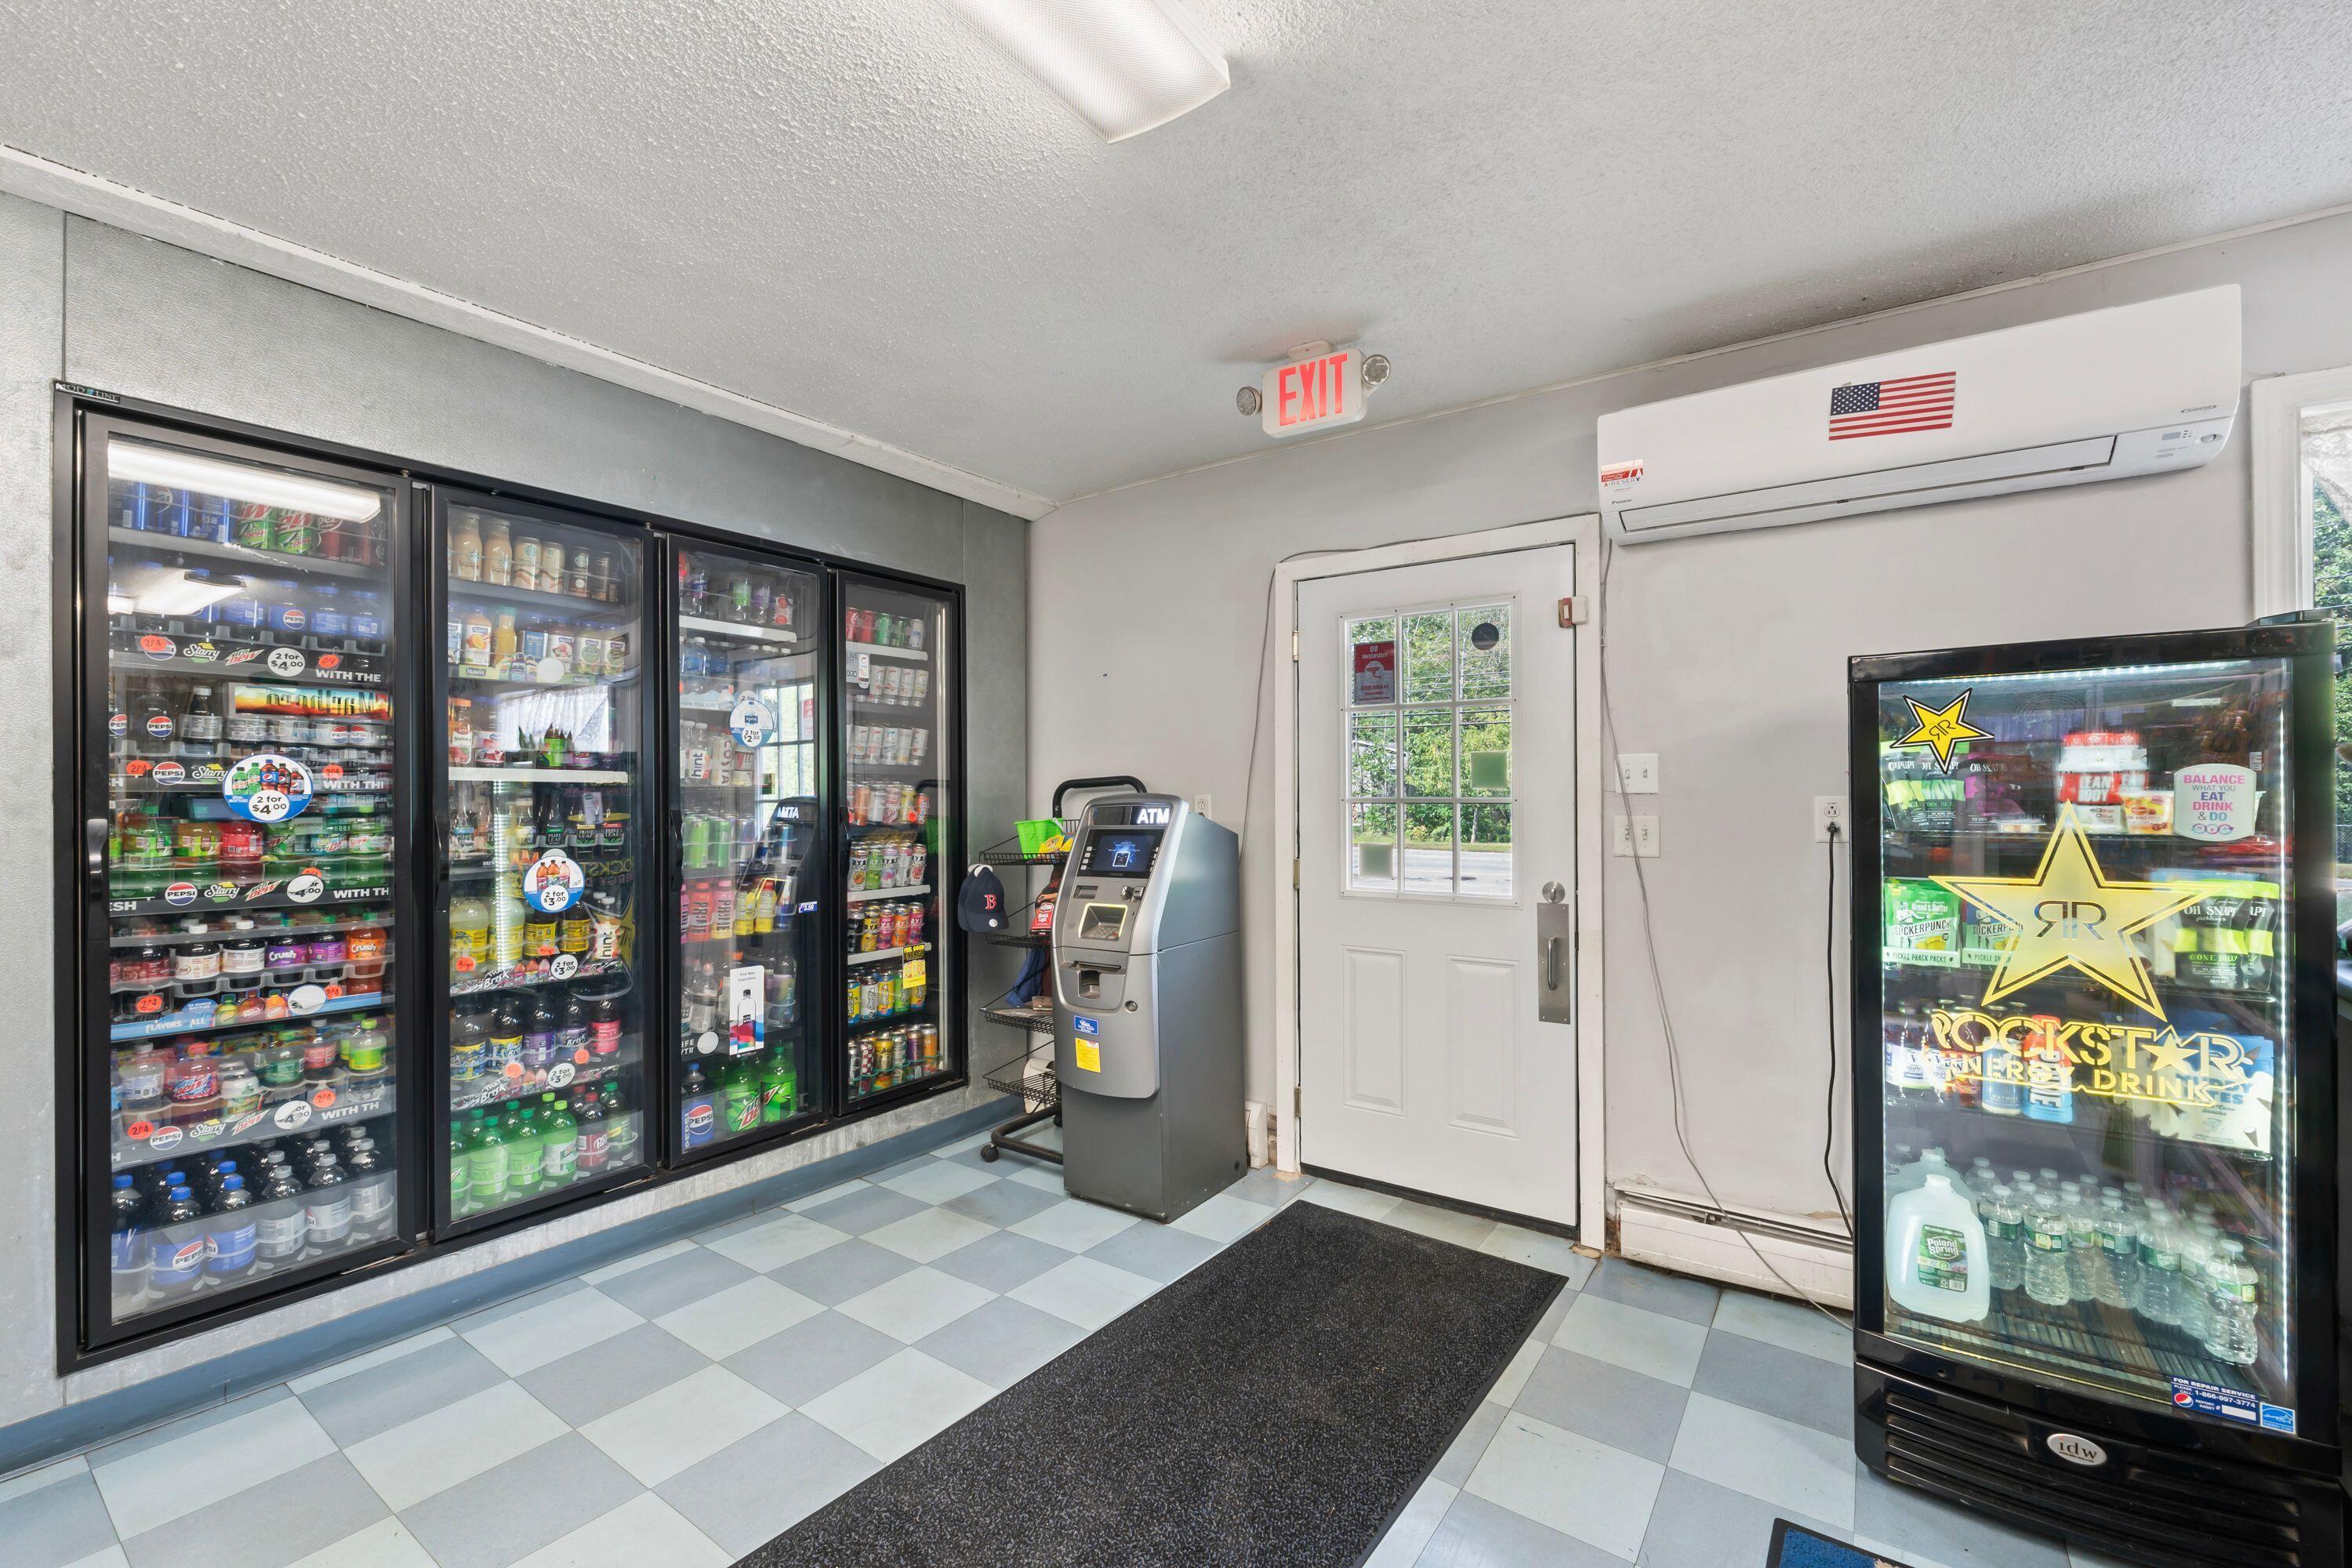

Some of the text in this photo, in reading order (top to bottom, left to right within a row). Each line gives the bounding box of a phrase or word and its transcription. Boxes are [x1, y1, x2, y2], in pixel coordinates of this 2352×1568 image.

[1279, 354, 1348, 426] EXIT
[183, 644, 220, 661] Starry
[270, 660, 303, 671] $4.00
[315, 669, 382, 683] WITH THE
[691, 753, 703, 777] hint
[192, 766, 228, 782] Starry
[2184, 775, 2245, 784] BALANCE
[323, 780, 360, 789] WITH
[2201, 792, 2224, 800] EAT
[252, 804, 287, 815] $4.00
[2193, 801, 2233, 811] DRINK
[1137, 808, 1170, 824] ATM
[2198, 811, 2227, 821] & DO
[204, 884, 240, 898] Starry
[333, 889, 370, 899] WITH
[543, 896, 567, 906] $3.00
[985, 895, 997, 909] B
[2183, 906, 2201, 915] OH
[1894, 920, 1950, 936] SUCKERPUNCH
[351, 942, 376, 953] Crush
[601, 931, 612, 958] hint
[269, 951, 296, 961] Crush
[1974, 953, 1992, 962] PICKLE
[554, 966, 575, 975] $3.00
[550, 1073, 572, 1083] $3.00
[2094, 1069, 2213, 1105] DRINK
[321, 1106, 359, 1120] WITH
[689, 1114, 713, 1126] PEPSI
[190, 1123, 226, 1138] Starry
[152, 1133, 182, 1143] PEPSI
[1927, 1237, 1958, 1250] Poland
[1928, 1246, 1959, 1258] Spring
[2191, 1381, 2220, 1392] REPAIR
[2221, 1388, 2256, 1399] SERVICE
